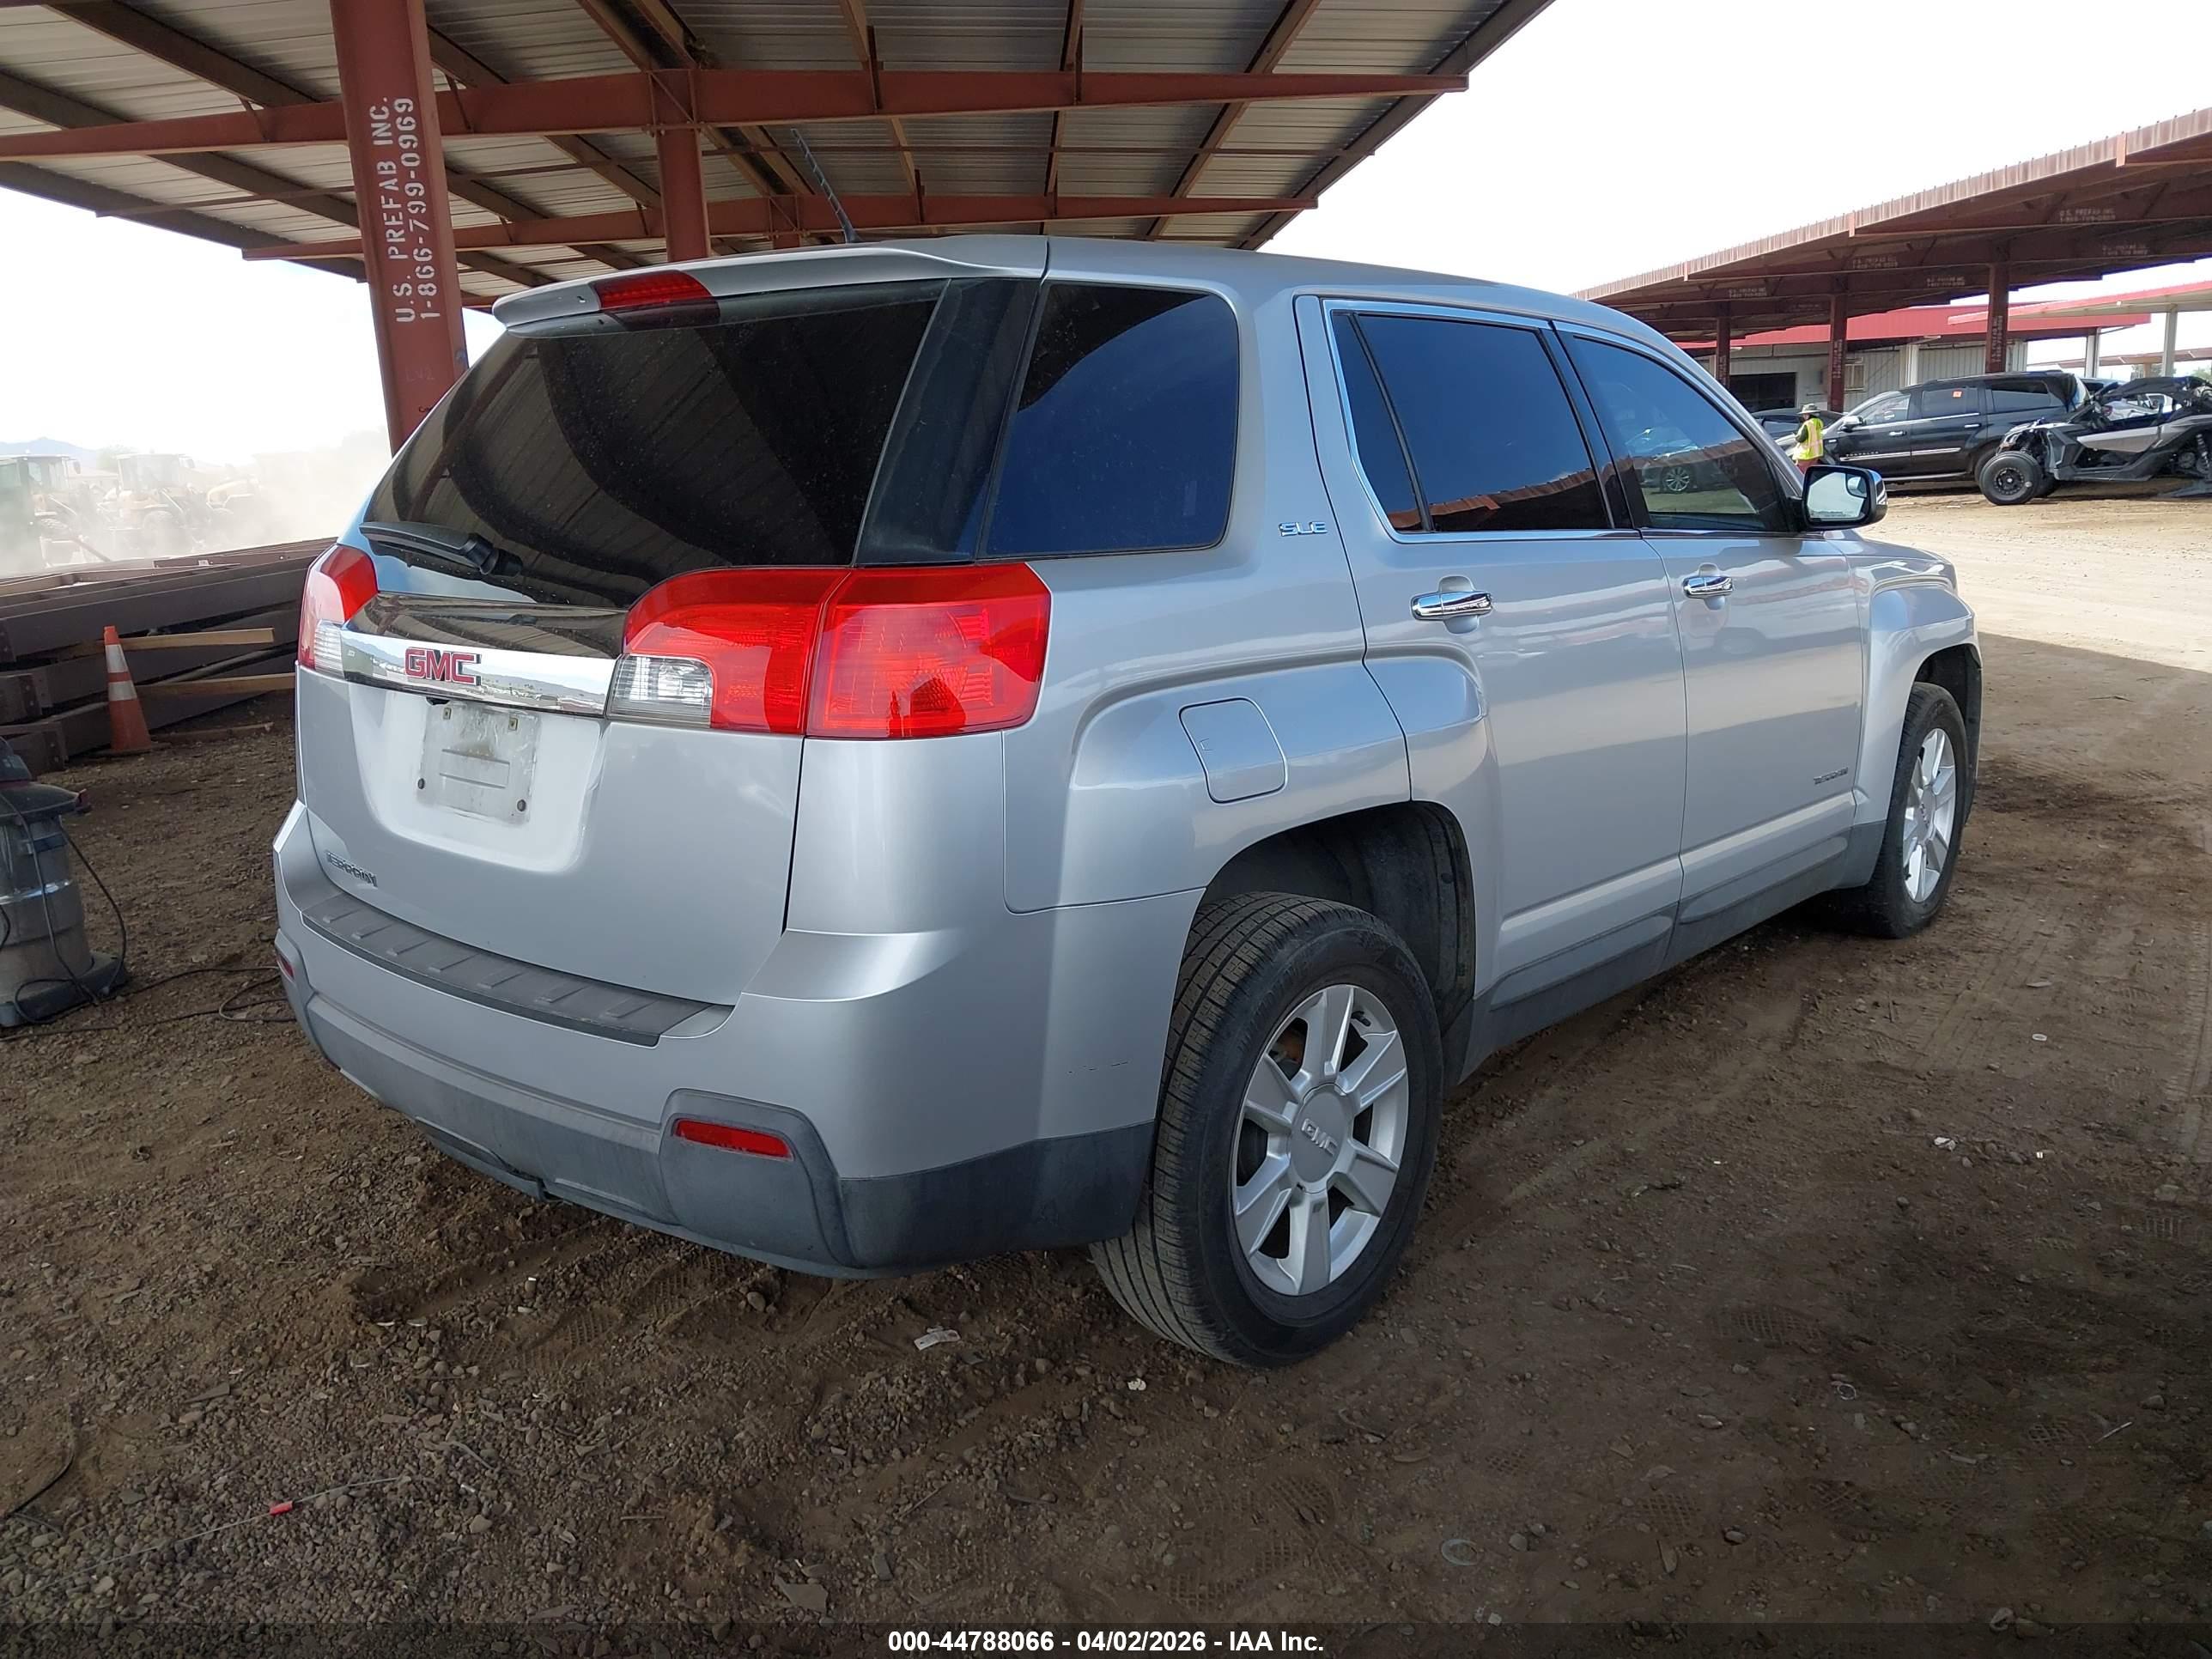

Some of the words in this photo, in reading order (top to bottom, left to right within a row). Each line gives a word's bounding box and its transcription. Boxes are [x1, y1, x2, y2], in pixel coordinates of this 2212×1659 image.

[369, 96, 394, 146] INC.
[376, 161, 409, 260] PREFAB
[393, 97, 441, 320] 1-866-799-0969
[392, 275, 416, 323] U.S.
[1279, 521, 1328, 537] SLE
[404, 647, 482, 686] GMC
[1301, 1118, 1339, 1157] GMC
